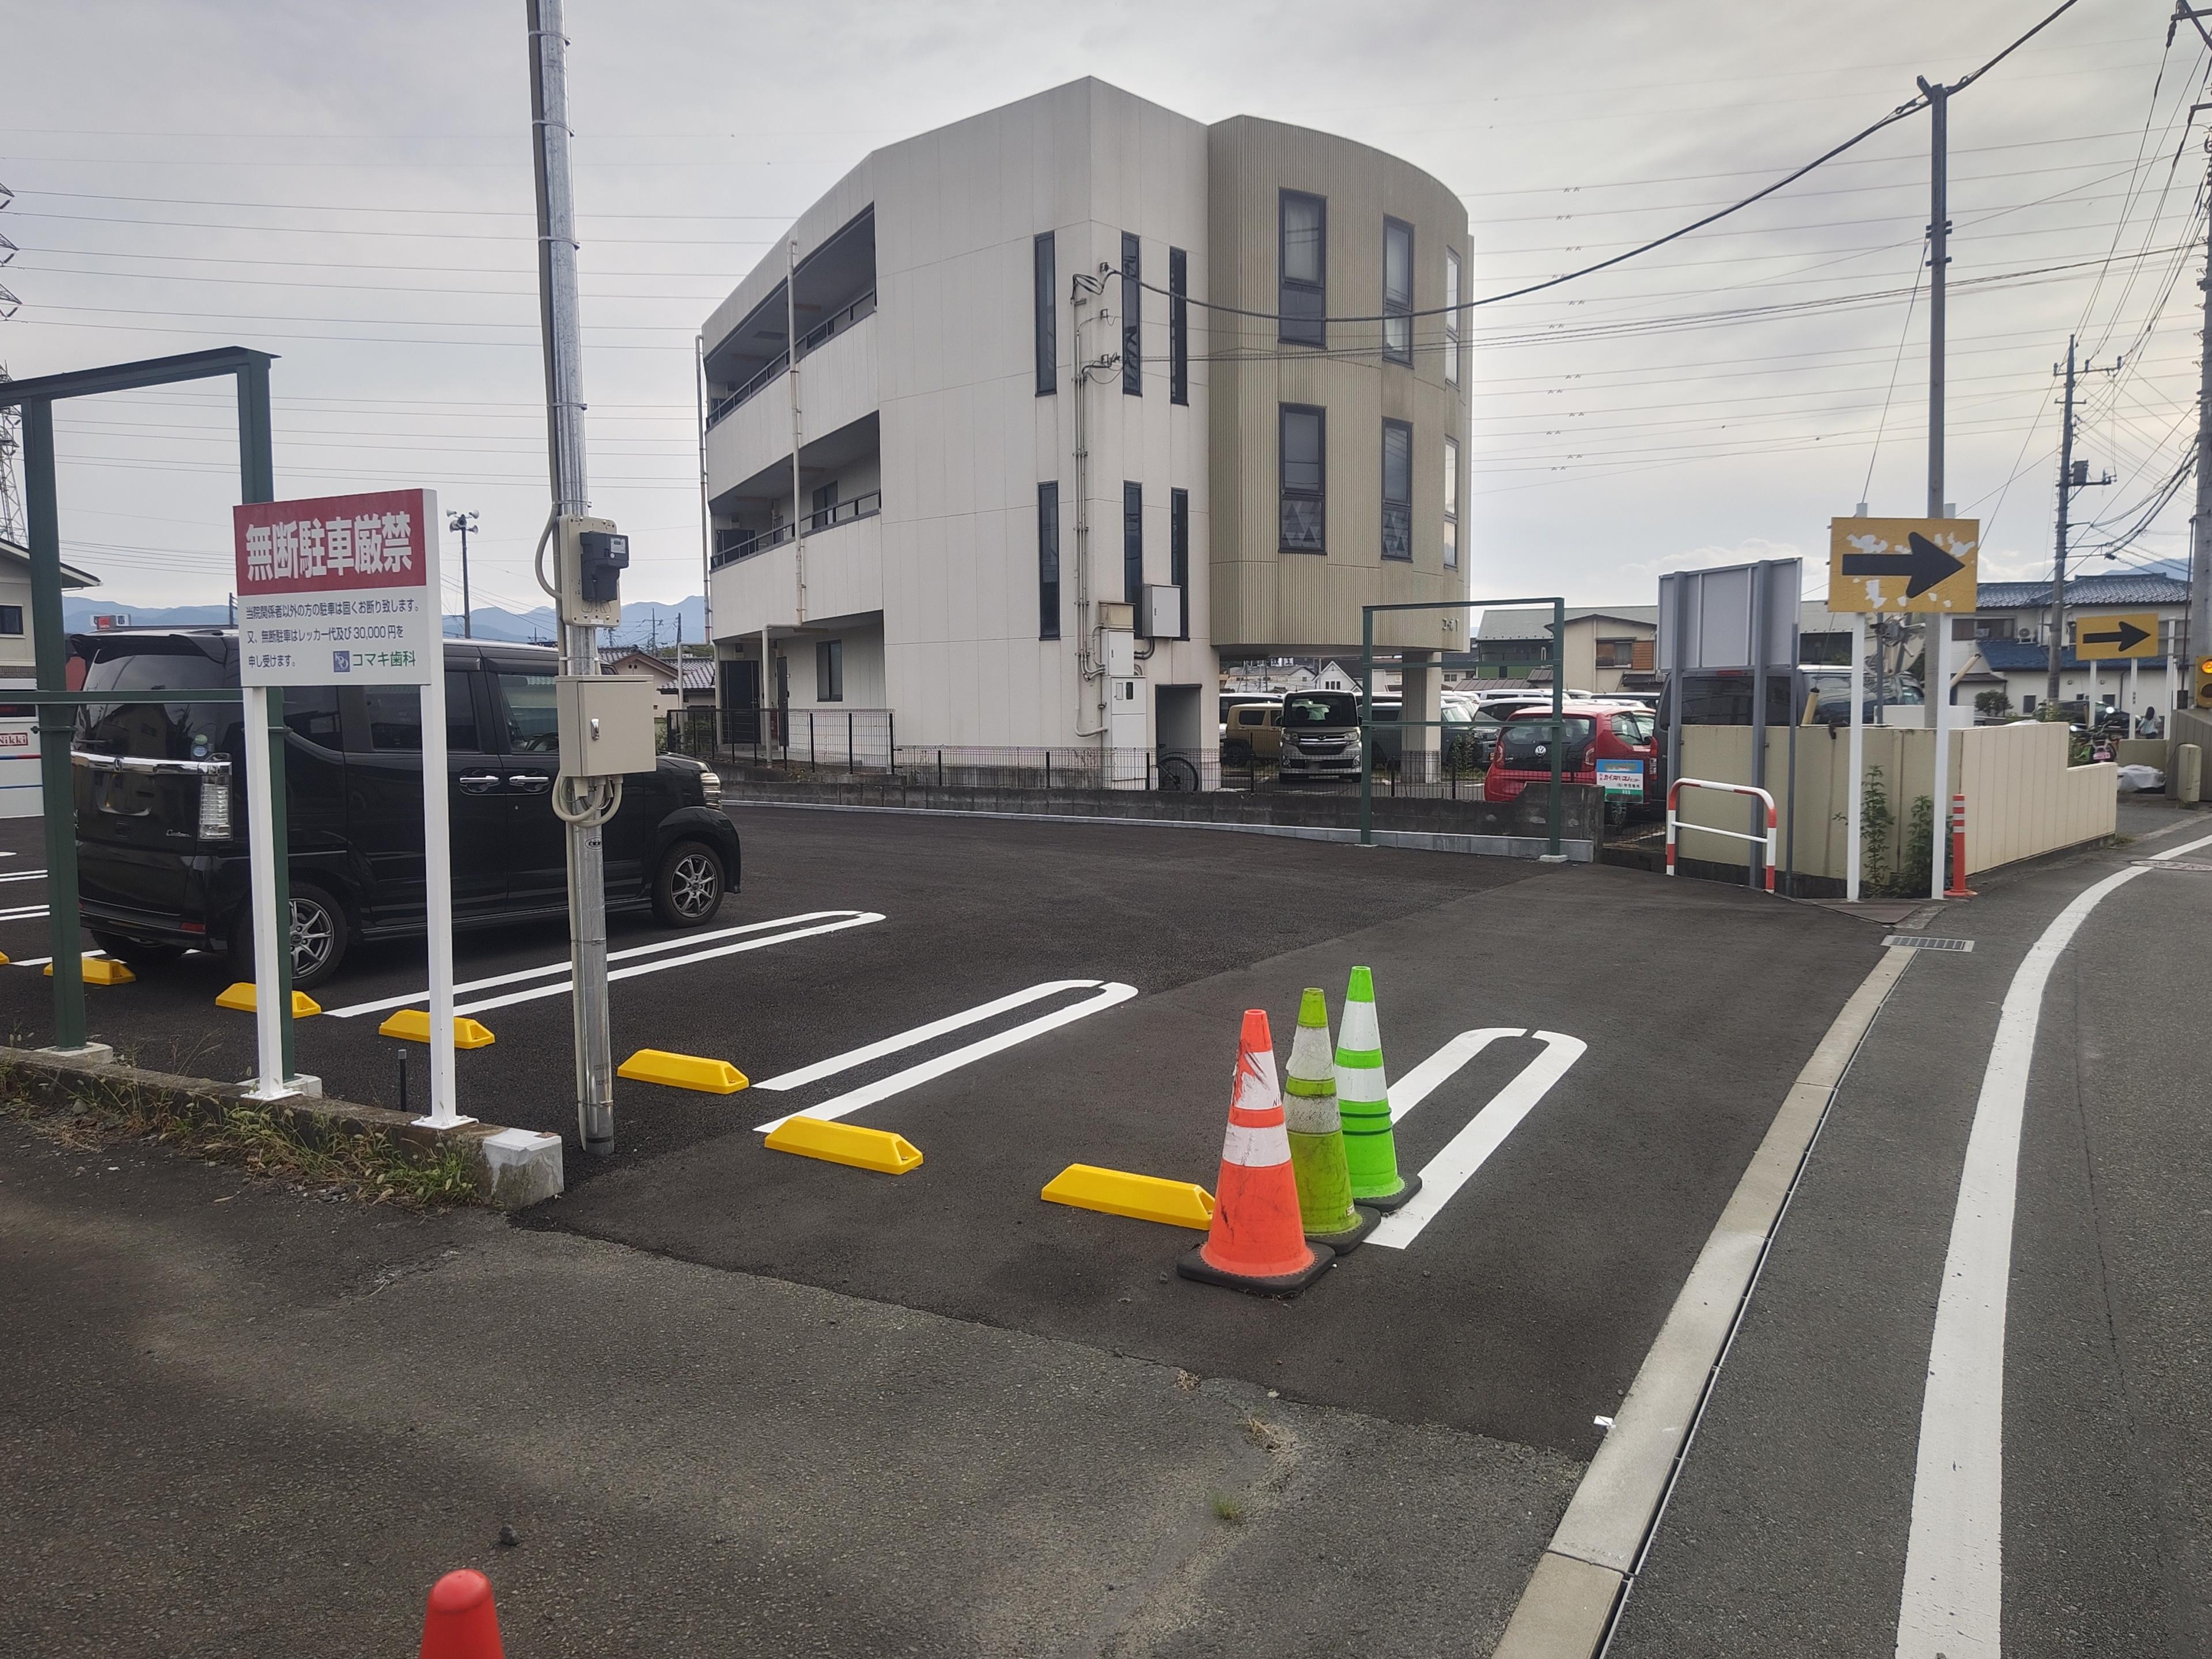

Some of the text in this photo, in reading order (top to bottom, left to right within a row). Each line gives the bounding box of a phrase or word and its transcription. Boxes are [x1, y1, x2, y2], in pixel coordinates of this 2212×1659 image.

[245, 510, 412, 582] 無断駐車厳禁
[248, 654, 296, 668] 申し受けます。
[353, 650, 416, 666] コマキ歯科
